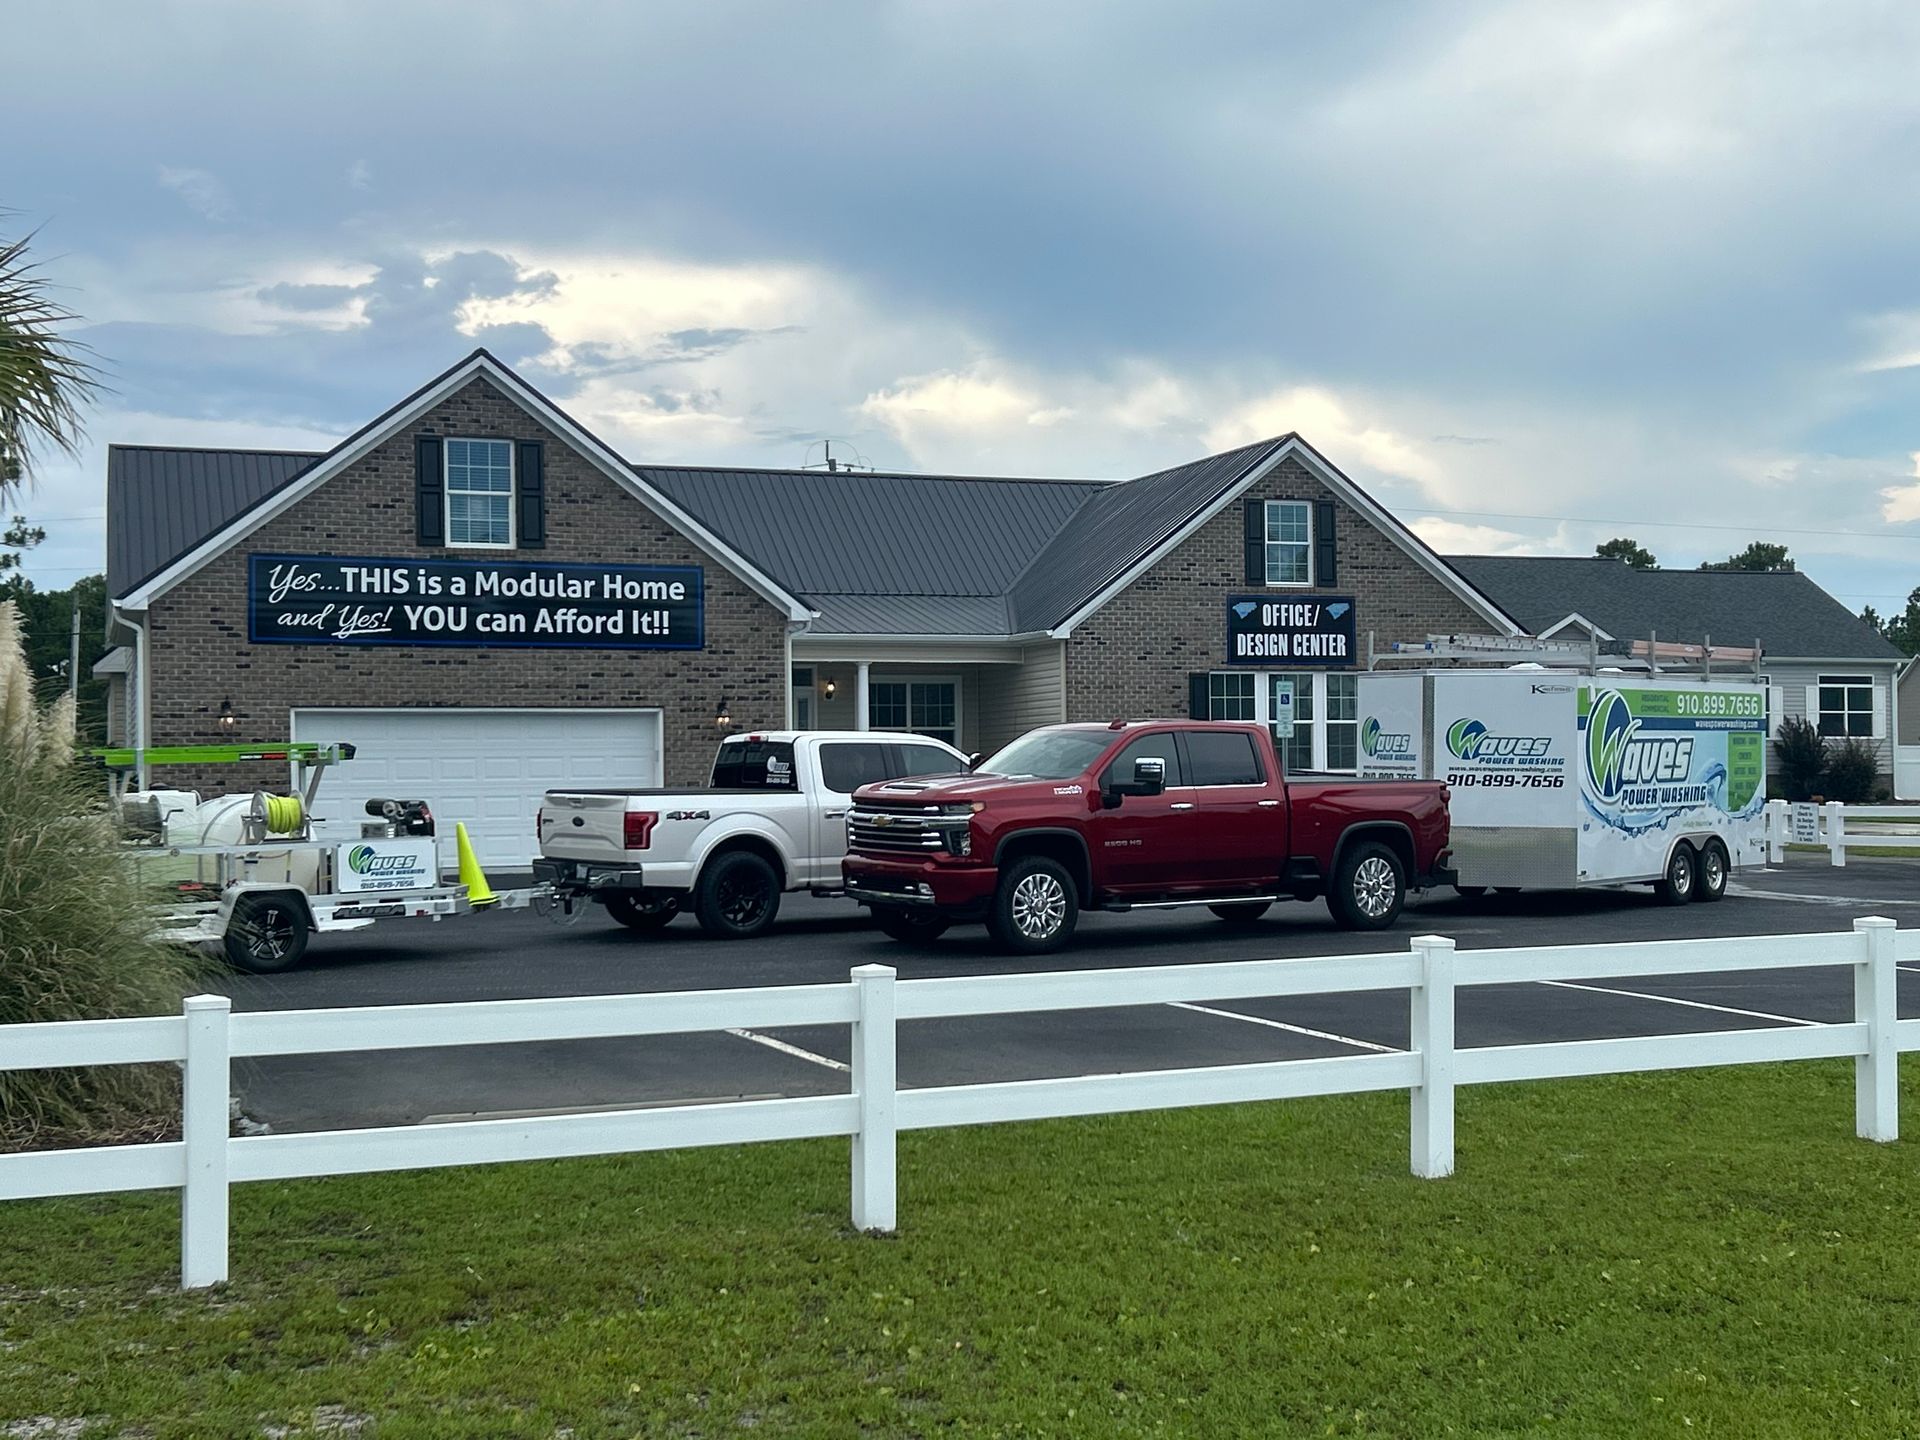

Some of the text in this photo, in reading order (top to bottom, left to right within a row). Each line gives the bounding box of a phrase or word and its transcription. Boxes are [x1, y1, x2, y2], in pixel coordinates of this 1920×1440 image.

[417, 568, 442, 596] is
[450, 574, 466, 597] a
[475, 571, 595, 600] Modular
[603, 574, 685, 601] Home
[277, 603, 670, 638] and Yes! YOU can Afford It!!
[1262, 603, 1321, 627] OFFICE/
[1237, 633, 1347, 657] DESIGN CENTER
[1677, 694, 1758, 716] 910.899.7656
[1695, 719, 1759, 730] wavespowerwashing.com
[1478, 757, 1565, 766] POWER WASHING
[1446, 773, 1565, 788] 910-899-7656
[1621, 784, 1707, 807] POWER WASHING
